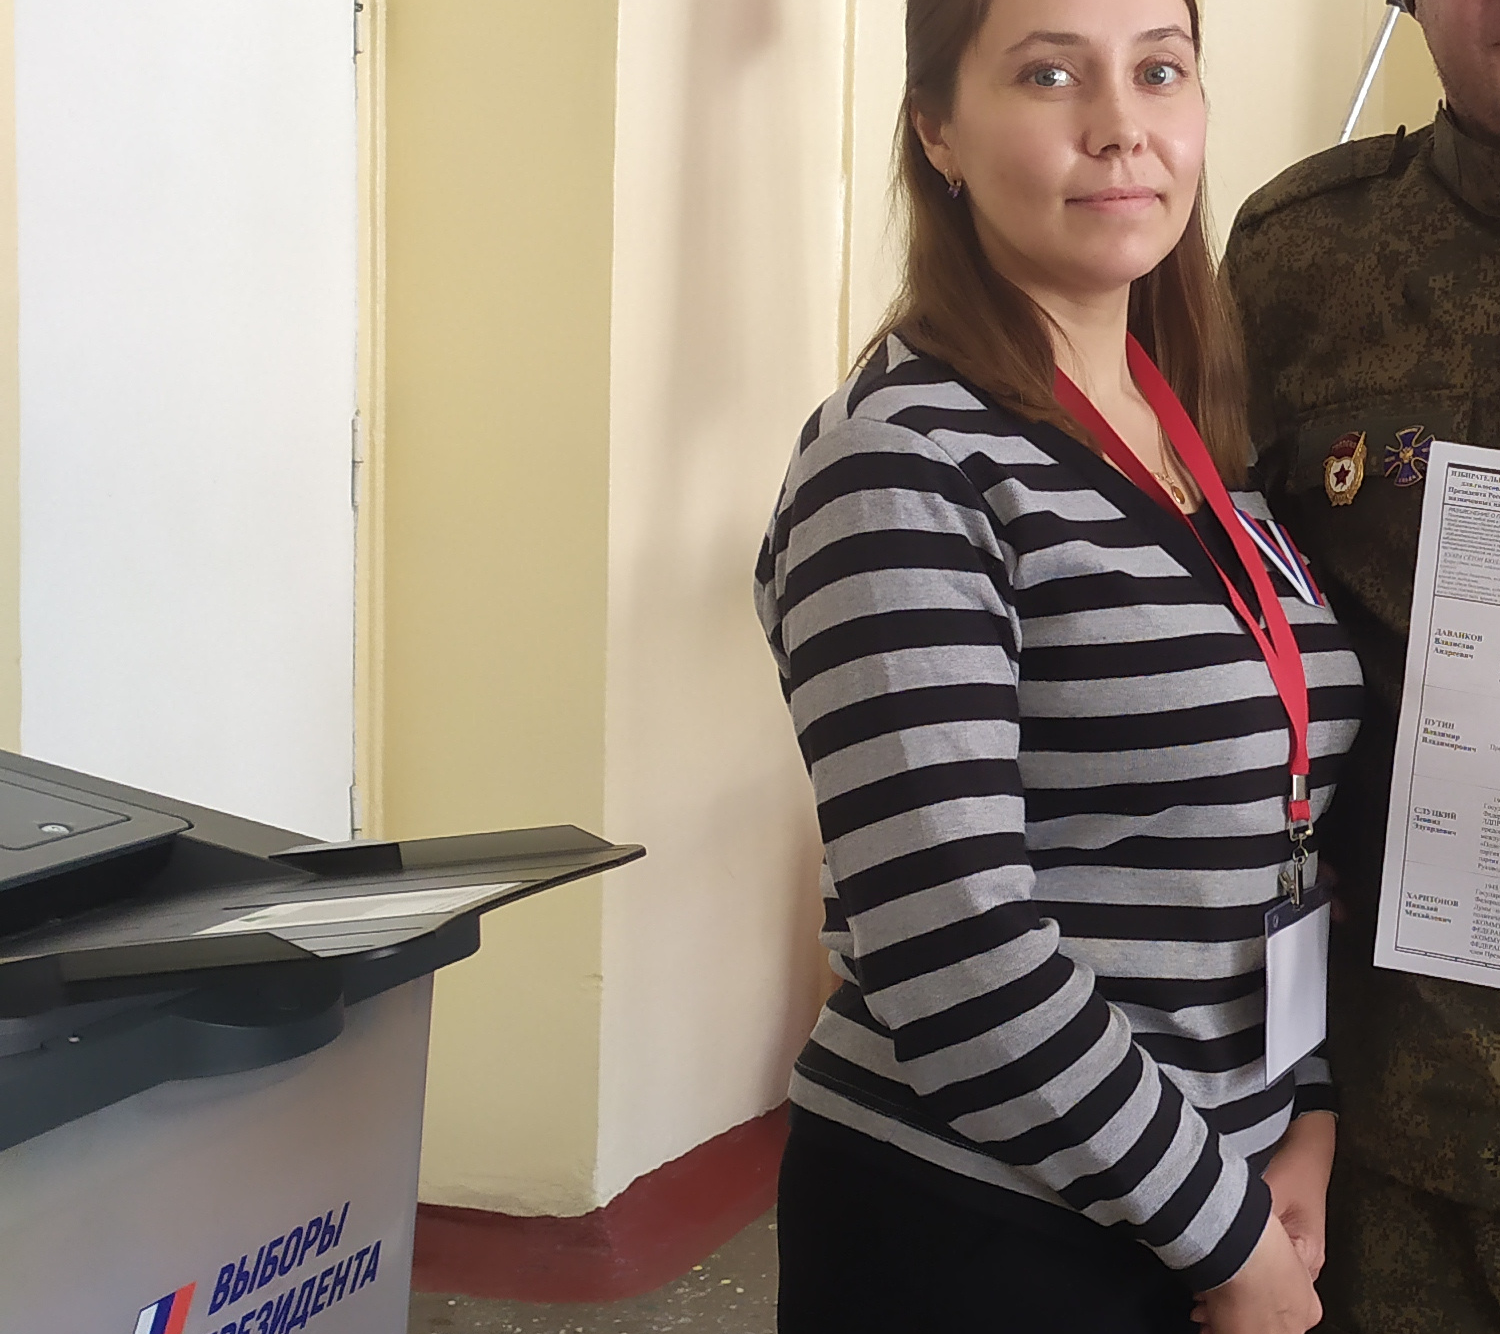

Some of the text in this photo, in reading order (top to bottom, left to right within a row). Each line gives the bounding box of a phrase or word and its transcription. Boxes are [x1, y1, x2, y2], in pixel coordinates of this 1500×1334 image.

[1434, 627, 1483, 644] ДАВАНКОВ
[1424, 717, 1455, 730] ПУТИН
[1422, 727, 1461, 742] Владимир
[1413, 804, 1457, 821] СЛУЦКИЙ
[207, 1200, 350, 1316] ВЫБОРЫ
